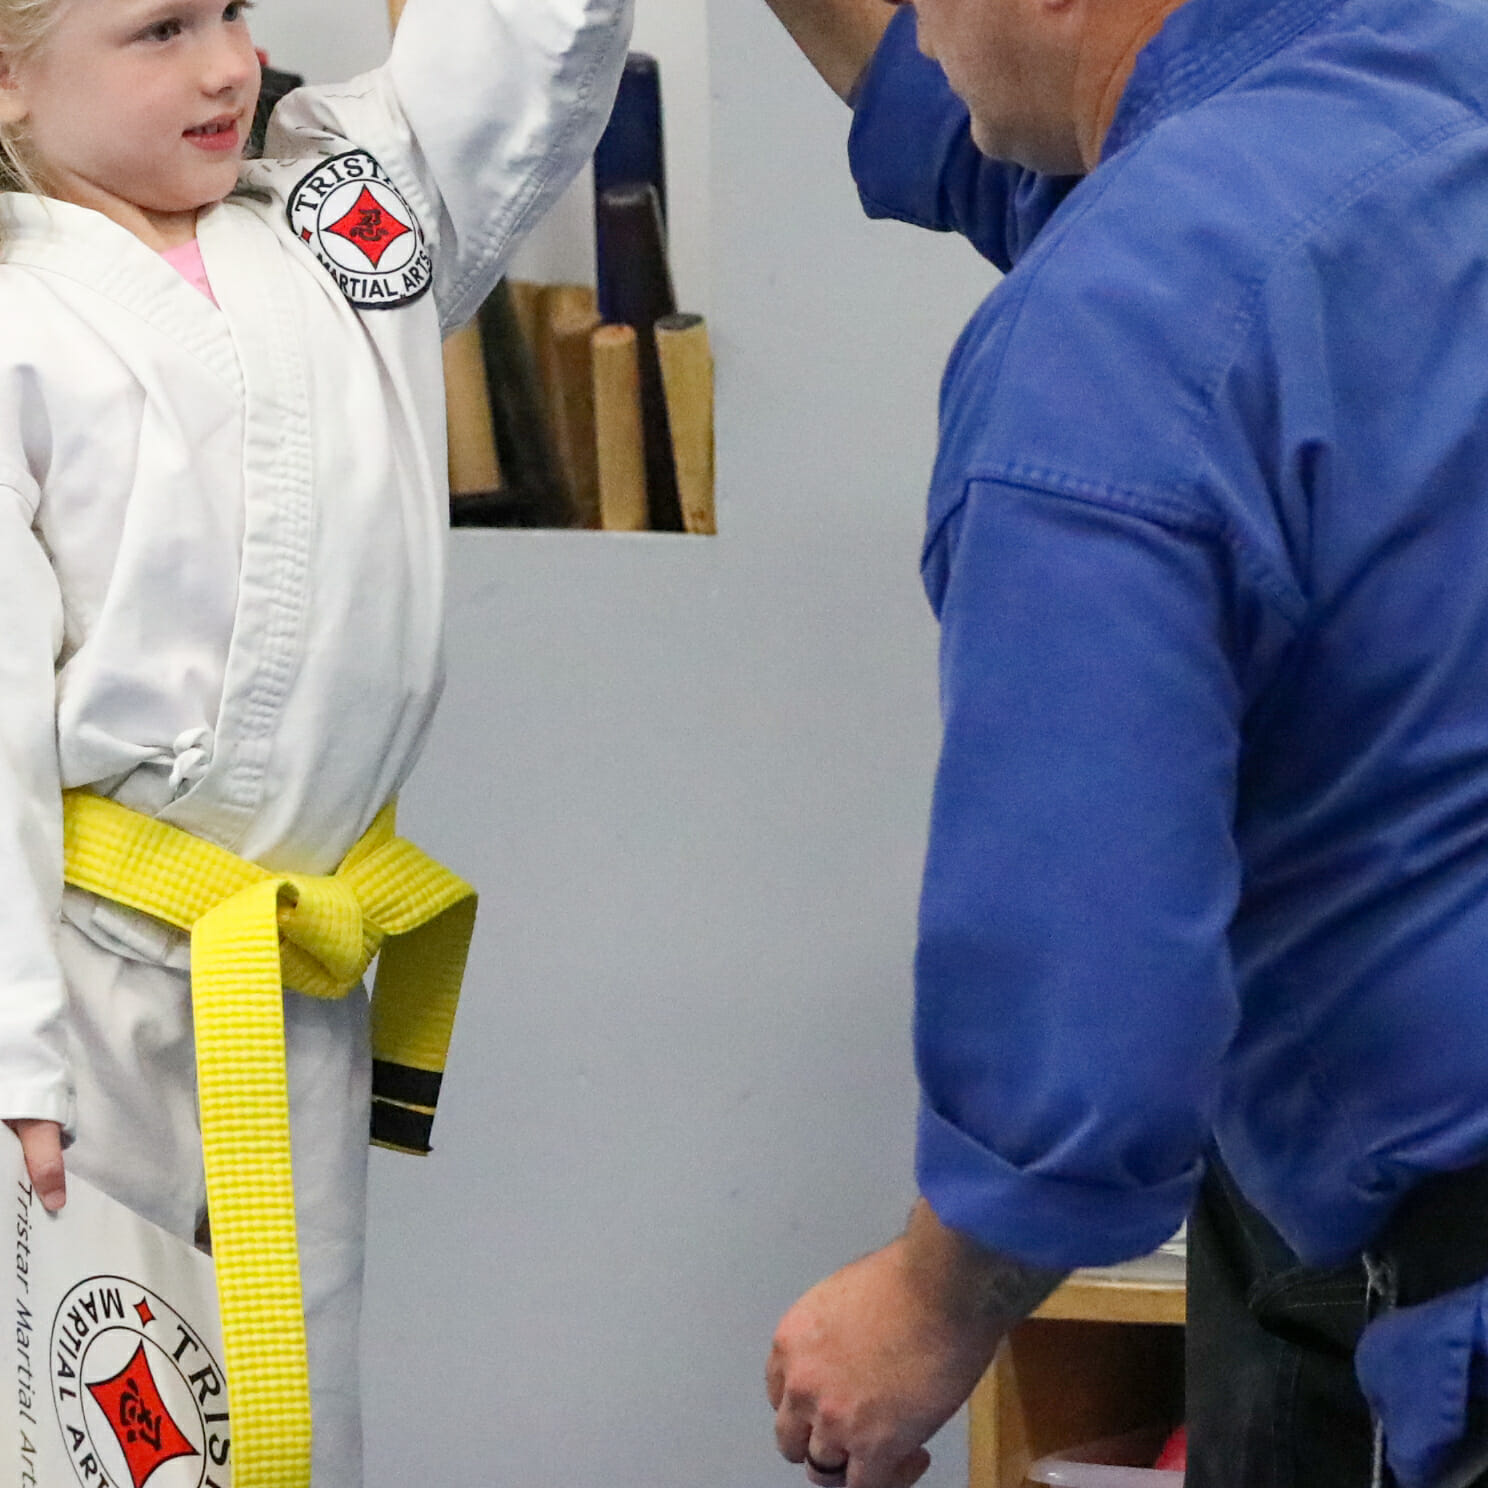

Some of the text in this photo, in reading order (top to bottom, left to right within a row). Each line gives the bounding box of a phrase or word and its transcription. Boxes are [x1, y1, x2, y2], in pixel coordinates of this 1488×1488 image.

[294, 157, 392, 212] TRIST
[401, 249, 432, 292] ARTS
[16, 1178, 33, 1295] Tristar
[15, 1297, 37, 1425] Martial
[56, 1287, 125, 1402] MARTIAL
